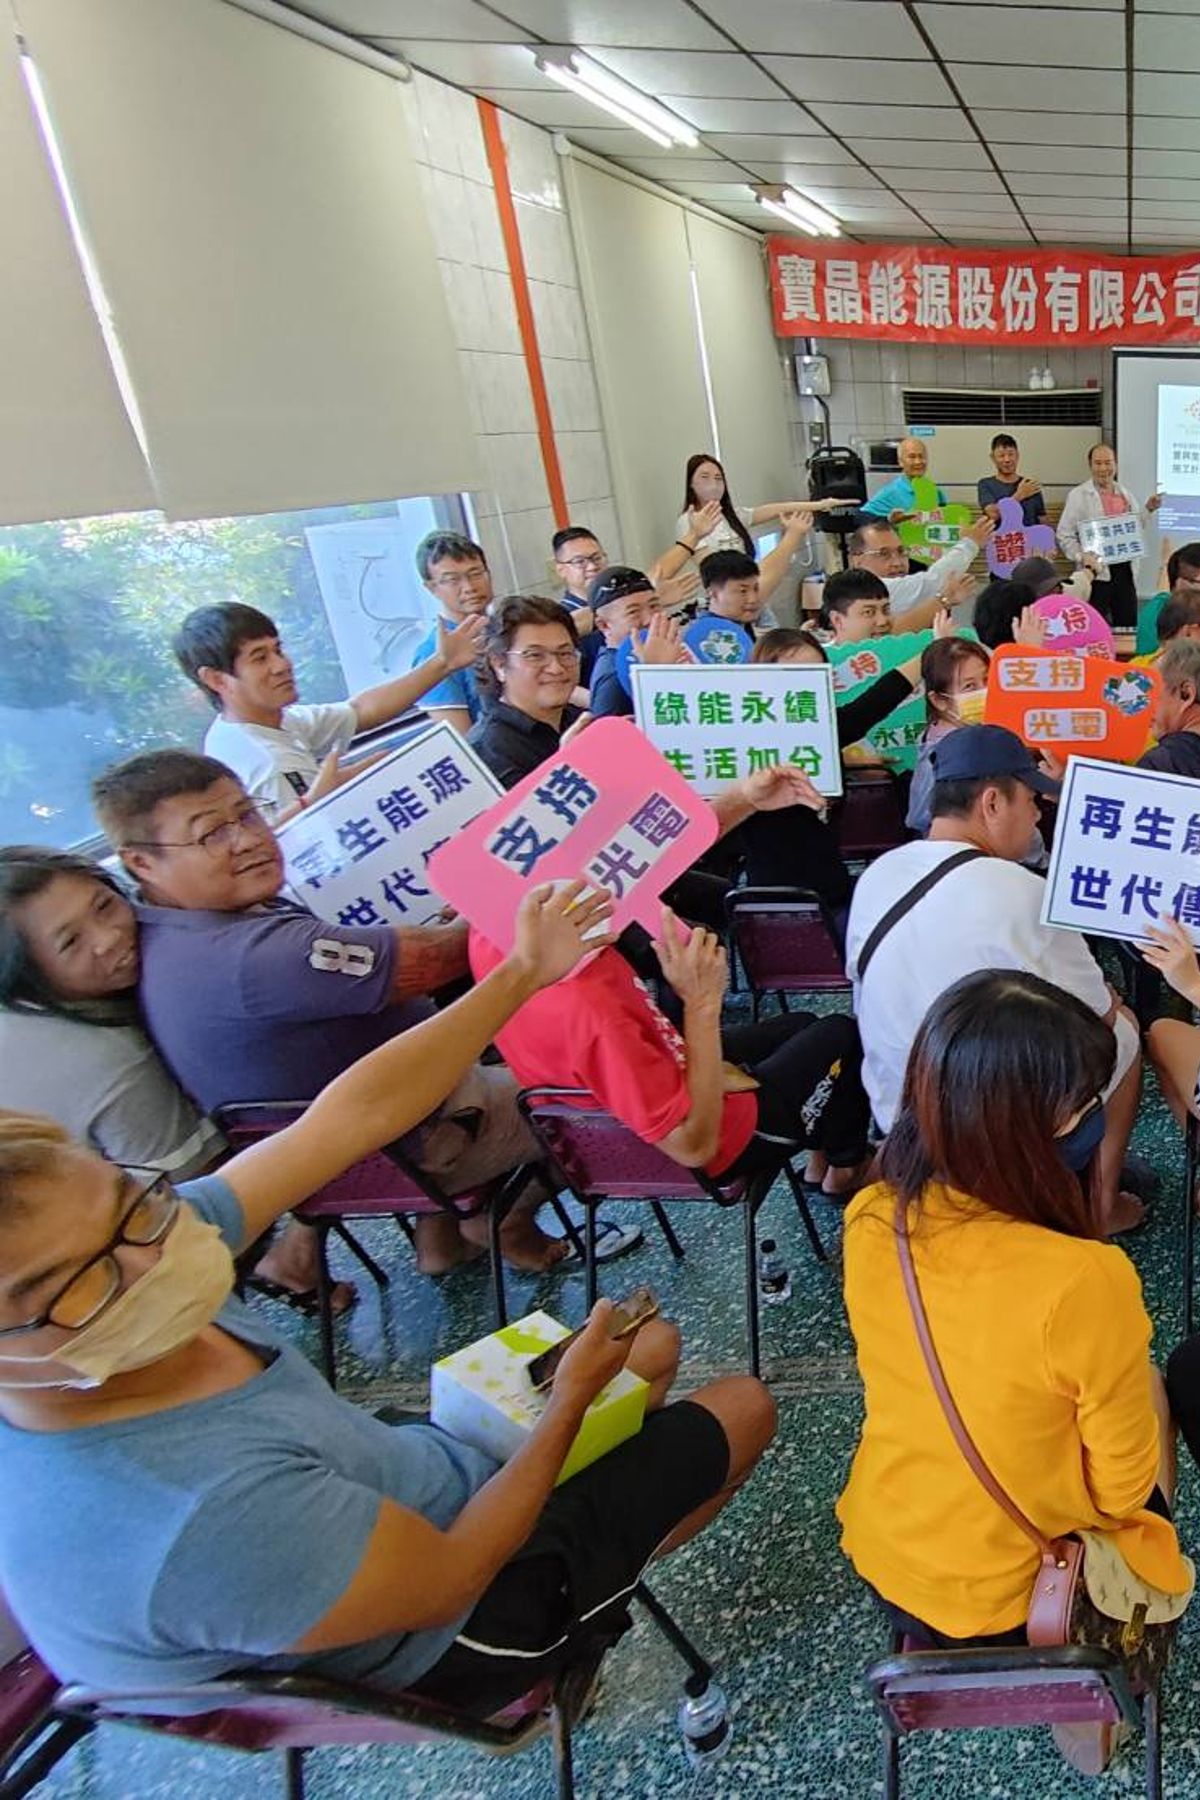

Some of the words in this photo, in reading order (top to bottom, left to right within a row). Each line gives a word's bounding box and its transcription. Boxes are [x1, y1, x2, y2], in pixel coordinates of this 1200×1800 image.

[1005, 659, 1081, 688] 支持
[653, 689, 820, 726] 綠能永續
[1030, 711, 1102, 738] 光電
[663, 745, 822, 780] 生活加分
[490, 764, 618, 878] 支持
[589, 792, 690, 899] 光電
[337, 837, 452, 926] 世代
